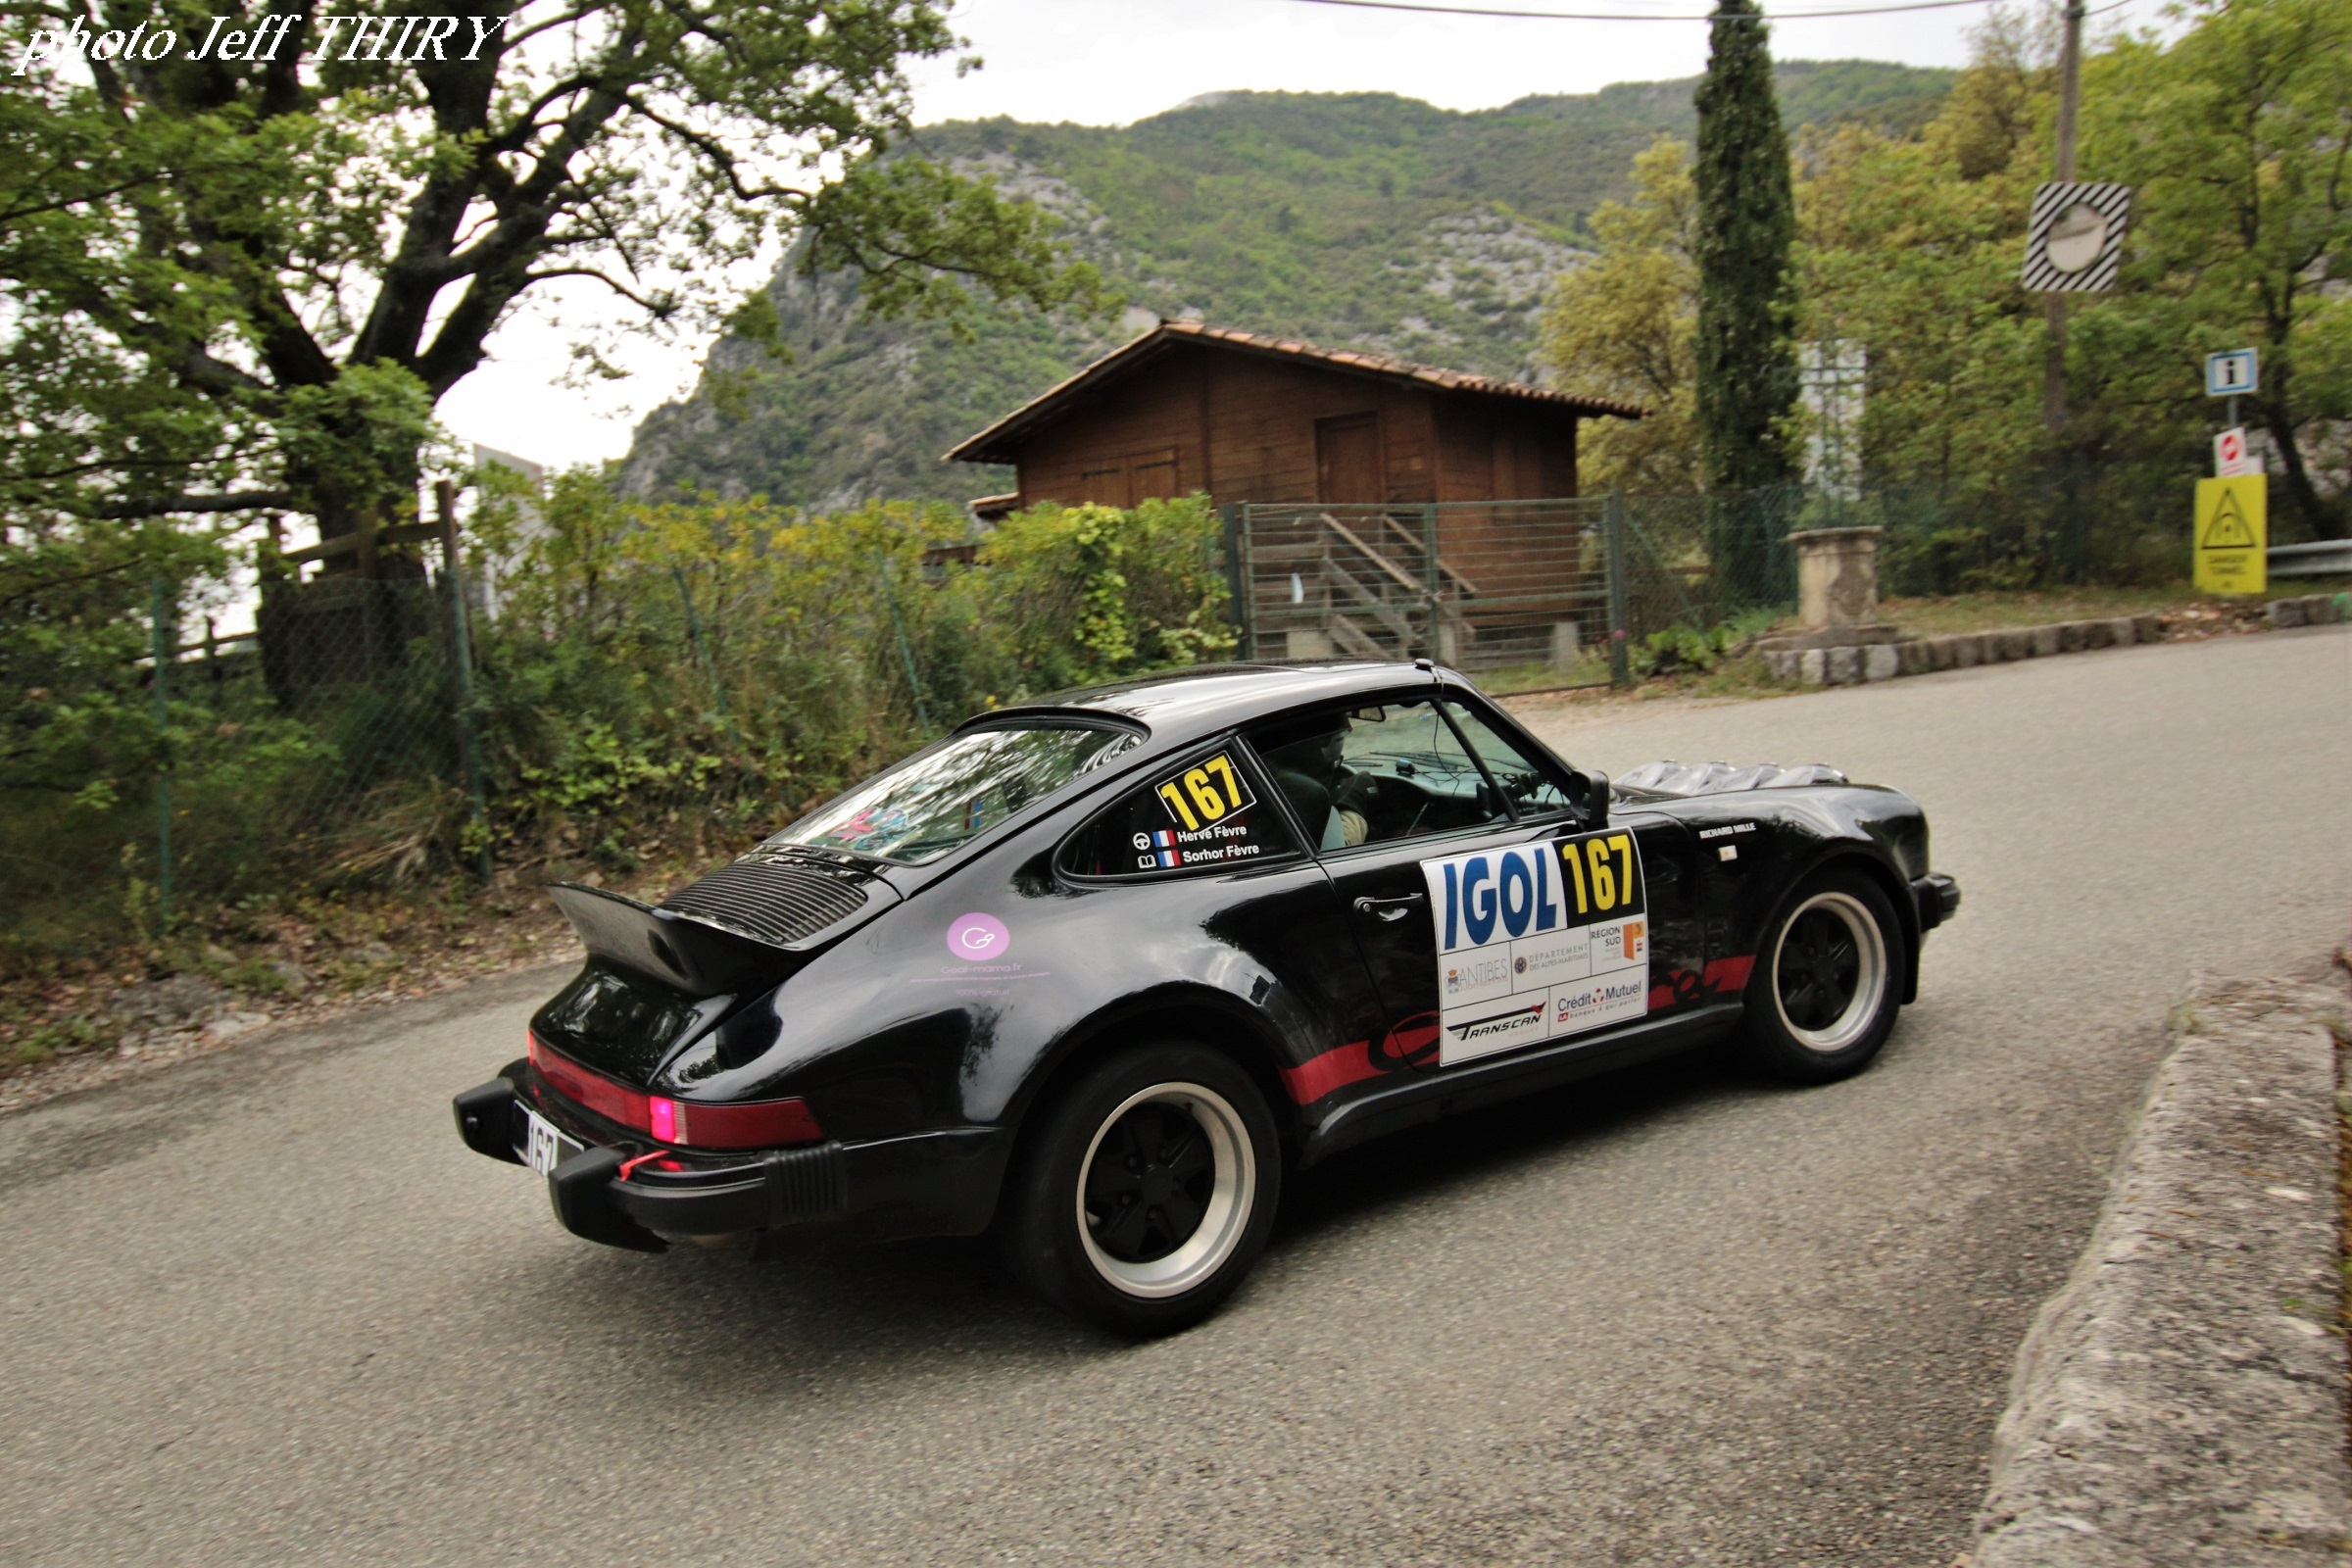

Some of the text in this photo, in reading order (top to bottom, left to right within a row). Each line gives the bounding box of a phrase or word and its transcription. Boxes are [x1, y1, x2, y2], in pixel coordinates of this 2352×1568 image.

[1160, 755, 1243, 831] 167
[1213, 826, 1248, 838] Fèvre
[1699, 822, 1757, 839] RICHARD MILLE
[1182, 845, 1260, 862] Sorhor Fèvre
[1562, 834, 1632, 914] 167
[1443, 848, 1556, 951] IGOL
[1529, 943, 1589, 962] DÉPARTEMENT
[1605, 936, 1621, 947] SUD
[1458, 957, 1508, 987] ANTIBES
[1529, 962, 1542, 971] DES
[1558, 993, 1592, 1012] Crédit
[1605, 981, 1642, 1001] Mutuel
[1448, 1006, 1544, 1041] TRANSCAN
[530, 1120, 555, 1176] 167
